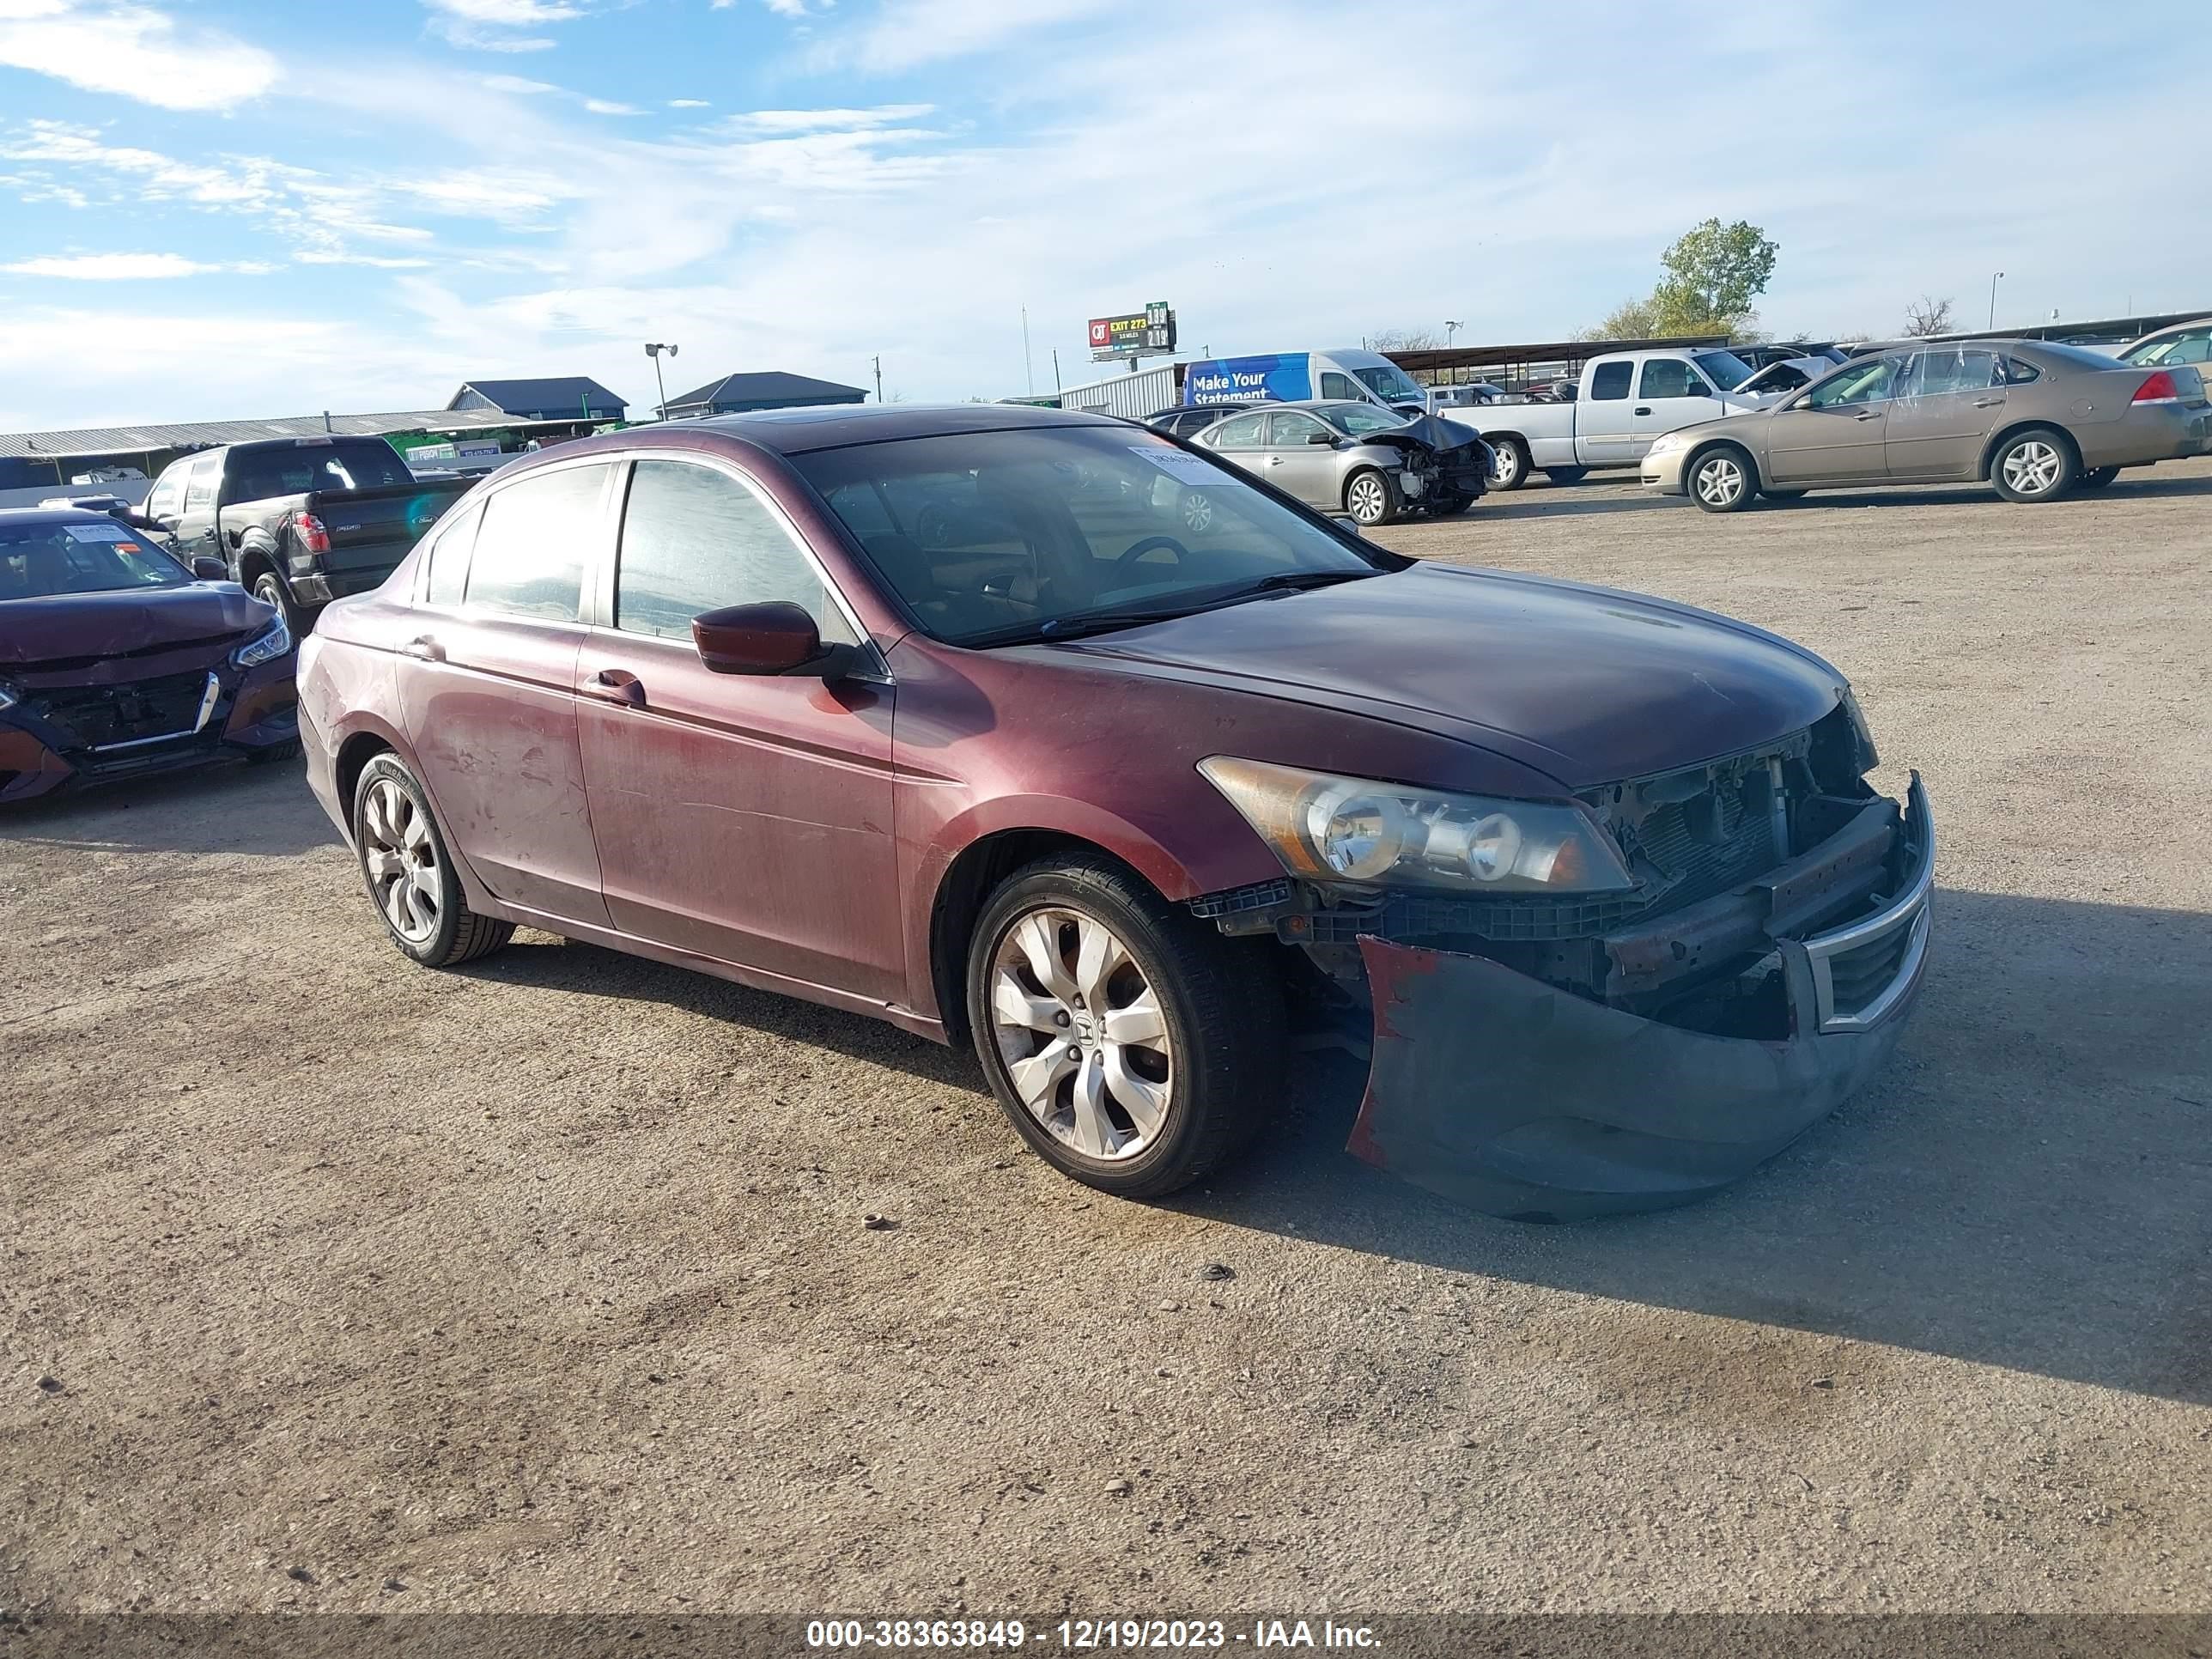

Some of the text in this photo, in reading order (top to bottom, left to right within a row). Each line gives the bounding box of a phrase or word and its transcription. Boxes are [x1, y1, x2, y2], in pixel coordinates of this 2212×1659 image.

[1091, 324, 1106, 342] QT
[1109, 319, 1146, 332] EXIT 273
[1194, 373, 1265, 392] Make Your
